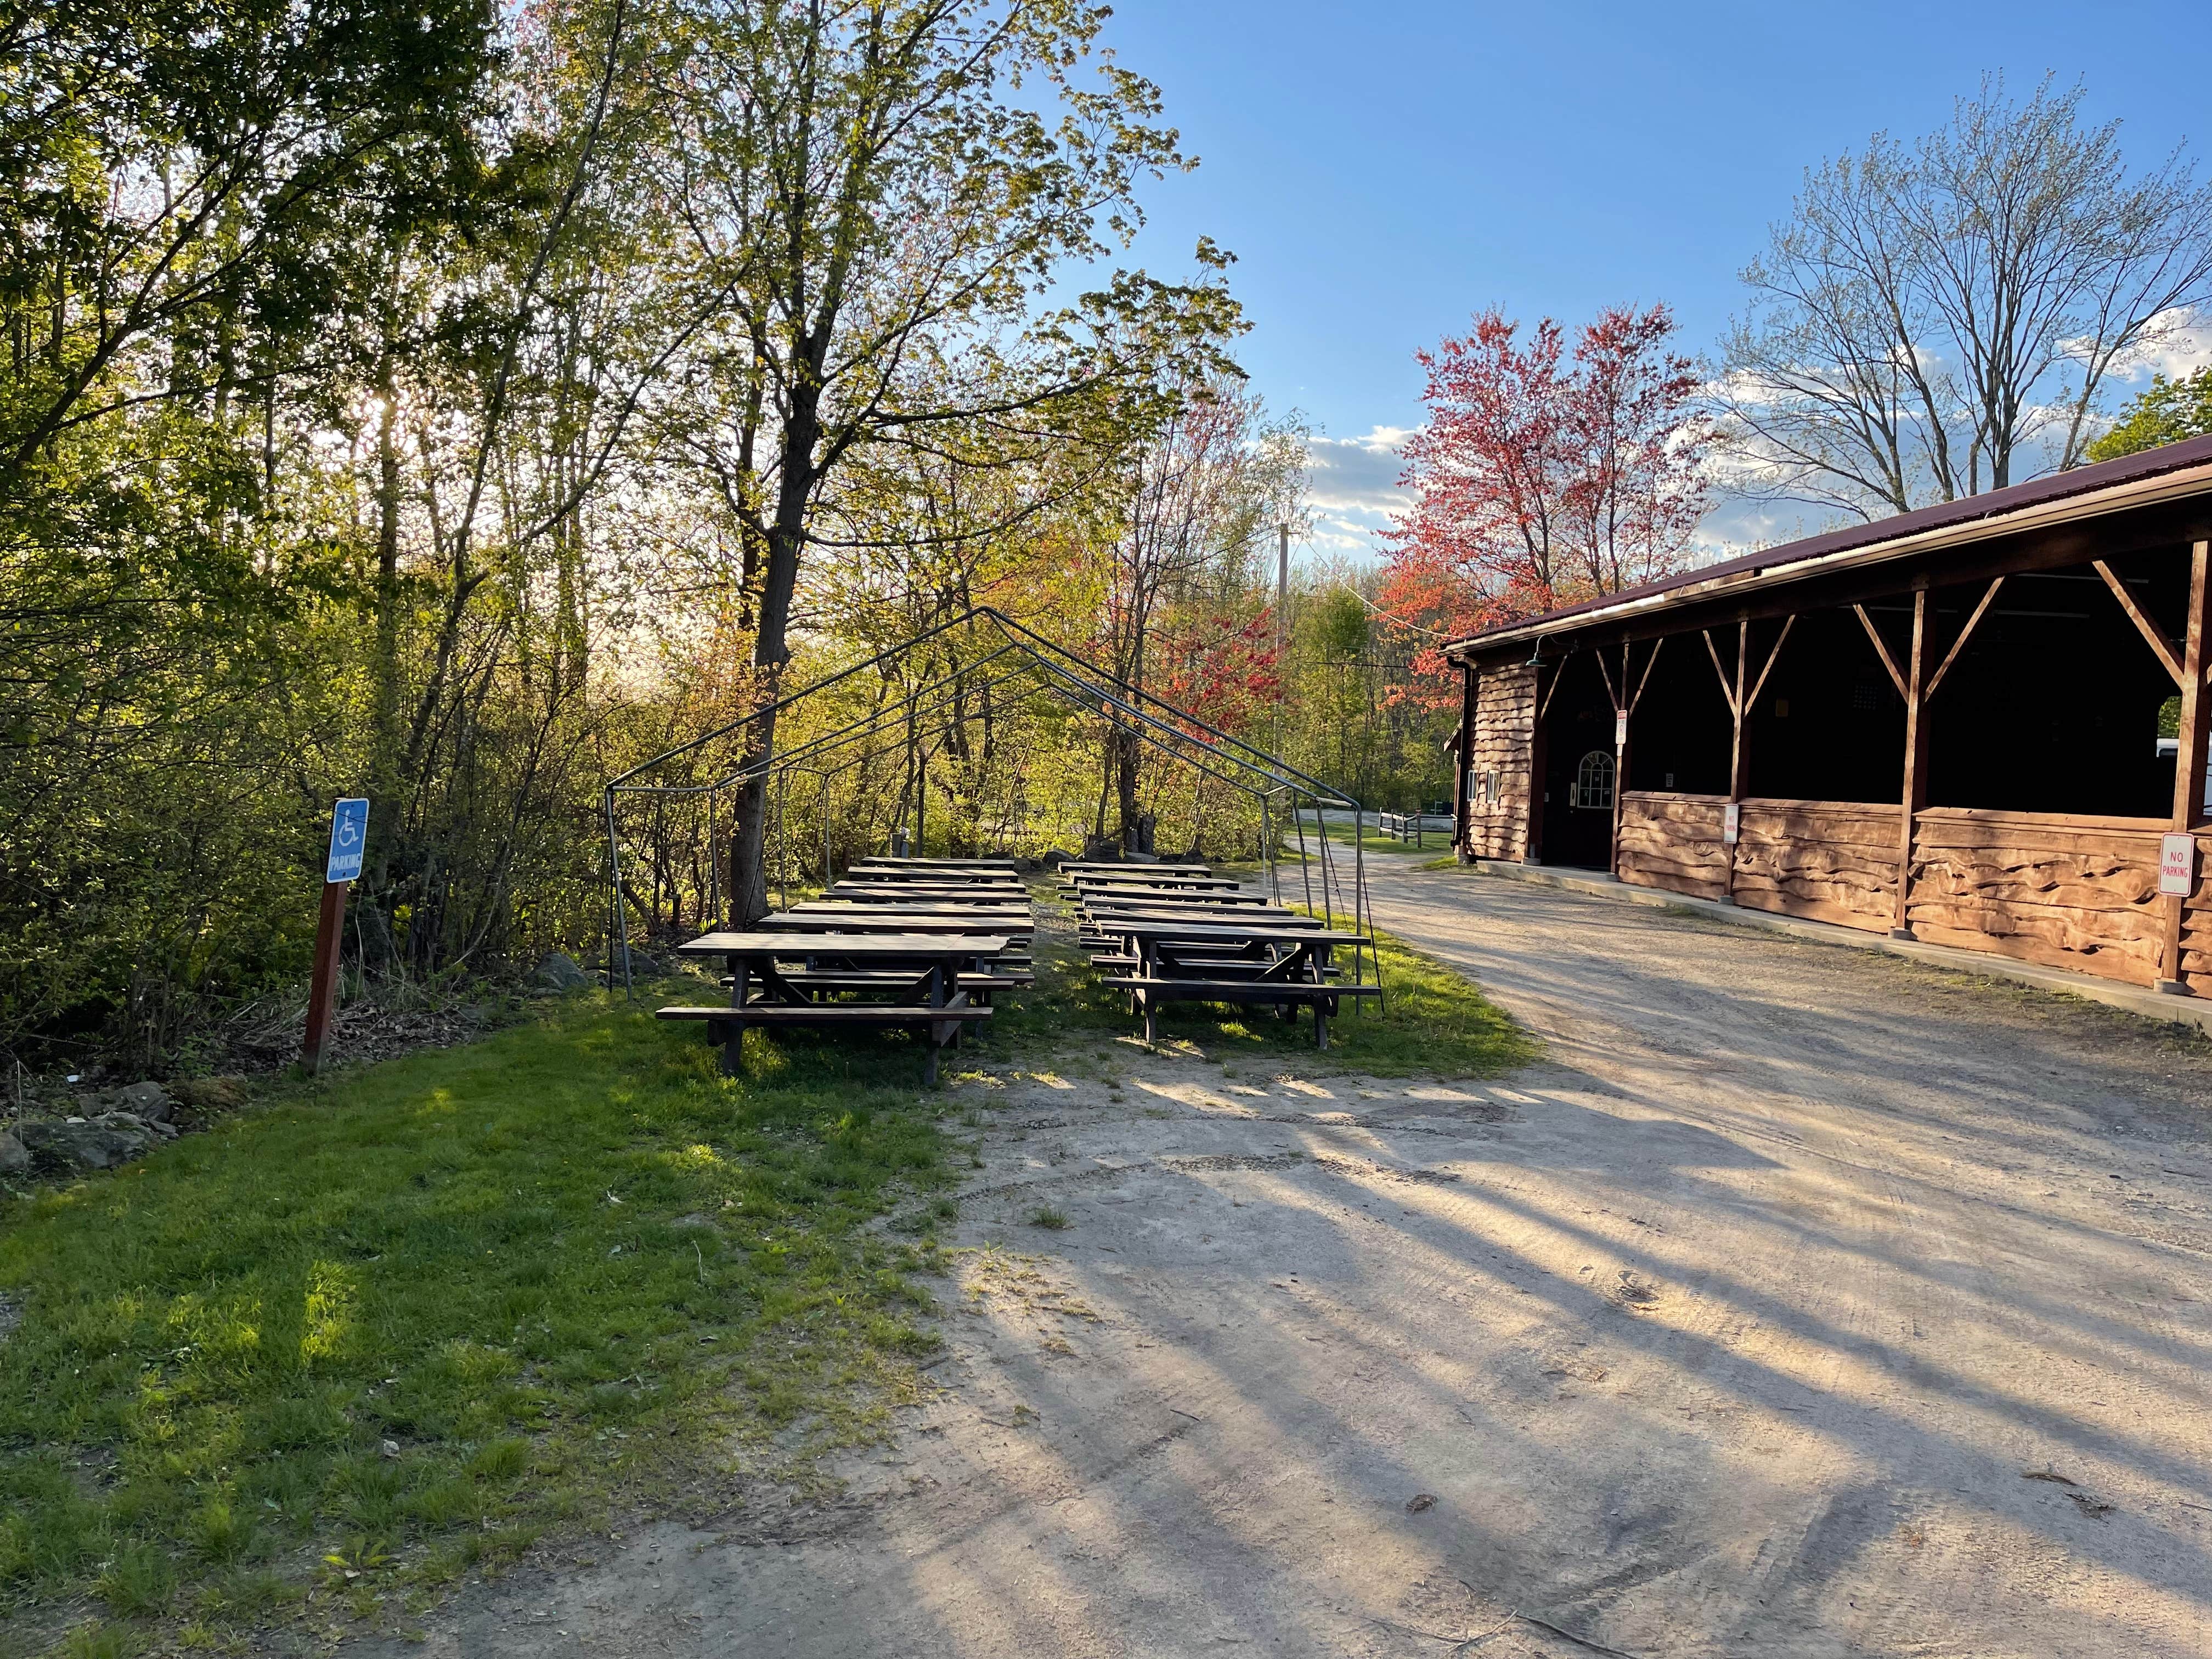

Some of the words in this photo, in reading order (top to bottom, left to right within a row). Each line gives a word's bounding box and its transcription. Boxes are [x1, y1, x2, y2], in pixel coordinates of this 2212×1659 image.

[330, 853, 361, 871] PARKING
[2170, 851, 2183, 862] NO
[2163, 865, 2188, 878] PARKING
